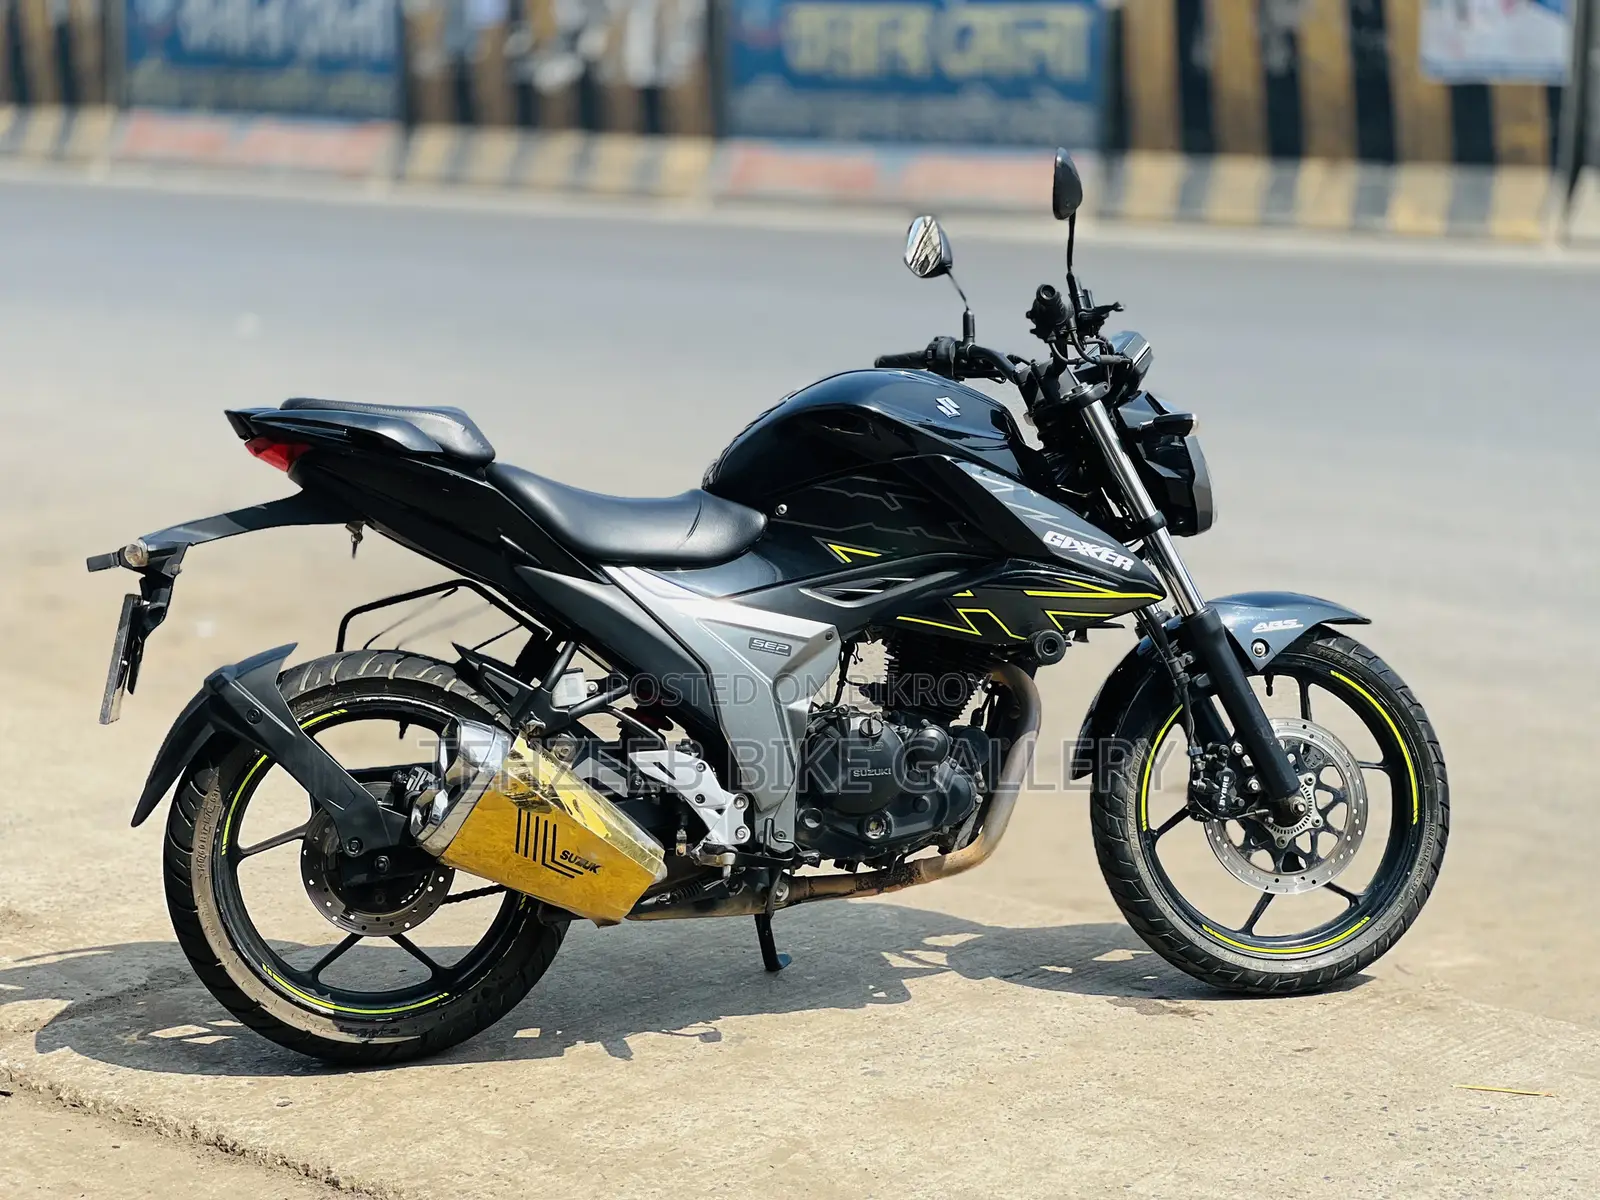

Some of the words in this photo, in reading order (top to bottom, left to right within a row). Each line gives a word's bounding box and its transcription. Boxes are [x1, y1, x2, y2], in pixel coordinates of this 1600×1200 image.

[1042, 530, 1135, 572] GIXXER
[1251, 618, 1304, 633] ABS
[751, 638, 789, 651] SEP
[853, 767, 892, 778] SUZUKI
